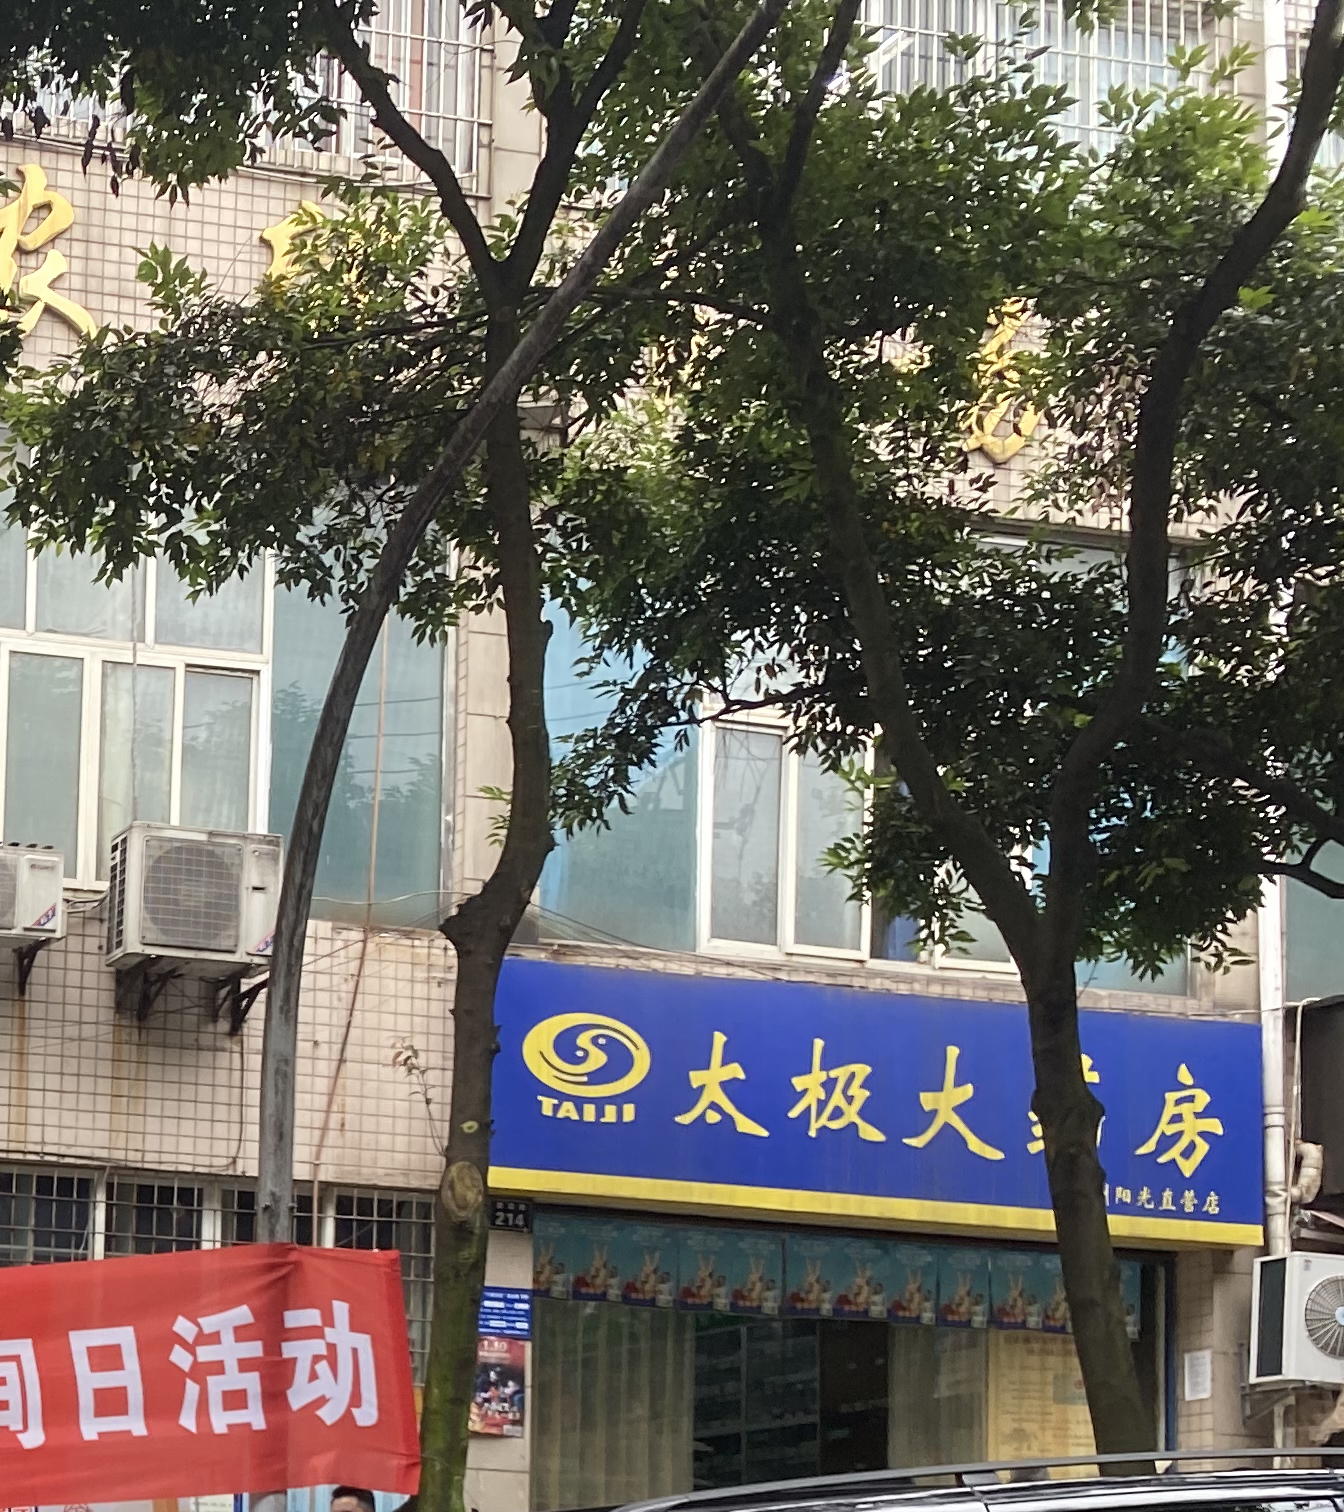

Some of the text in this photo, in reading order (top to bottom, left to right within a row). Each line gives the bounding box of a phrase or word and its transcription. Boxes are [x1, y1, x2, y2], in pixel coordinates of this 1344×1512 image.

[537, 1095, 636, 1123] TAIJI
[674, 1031, 1224, 1178] 太极大房
